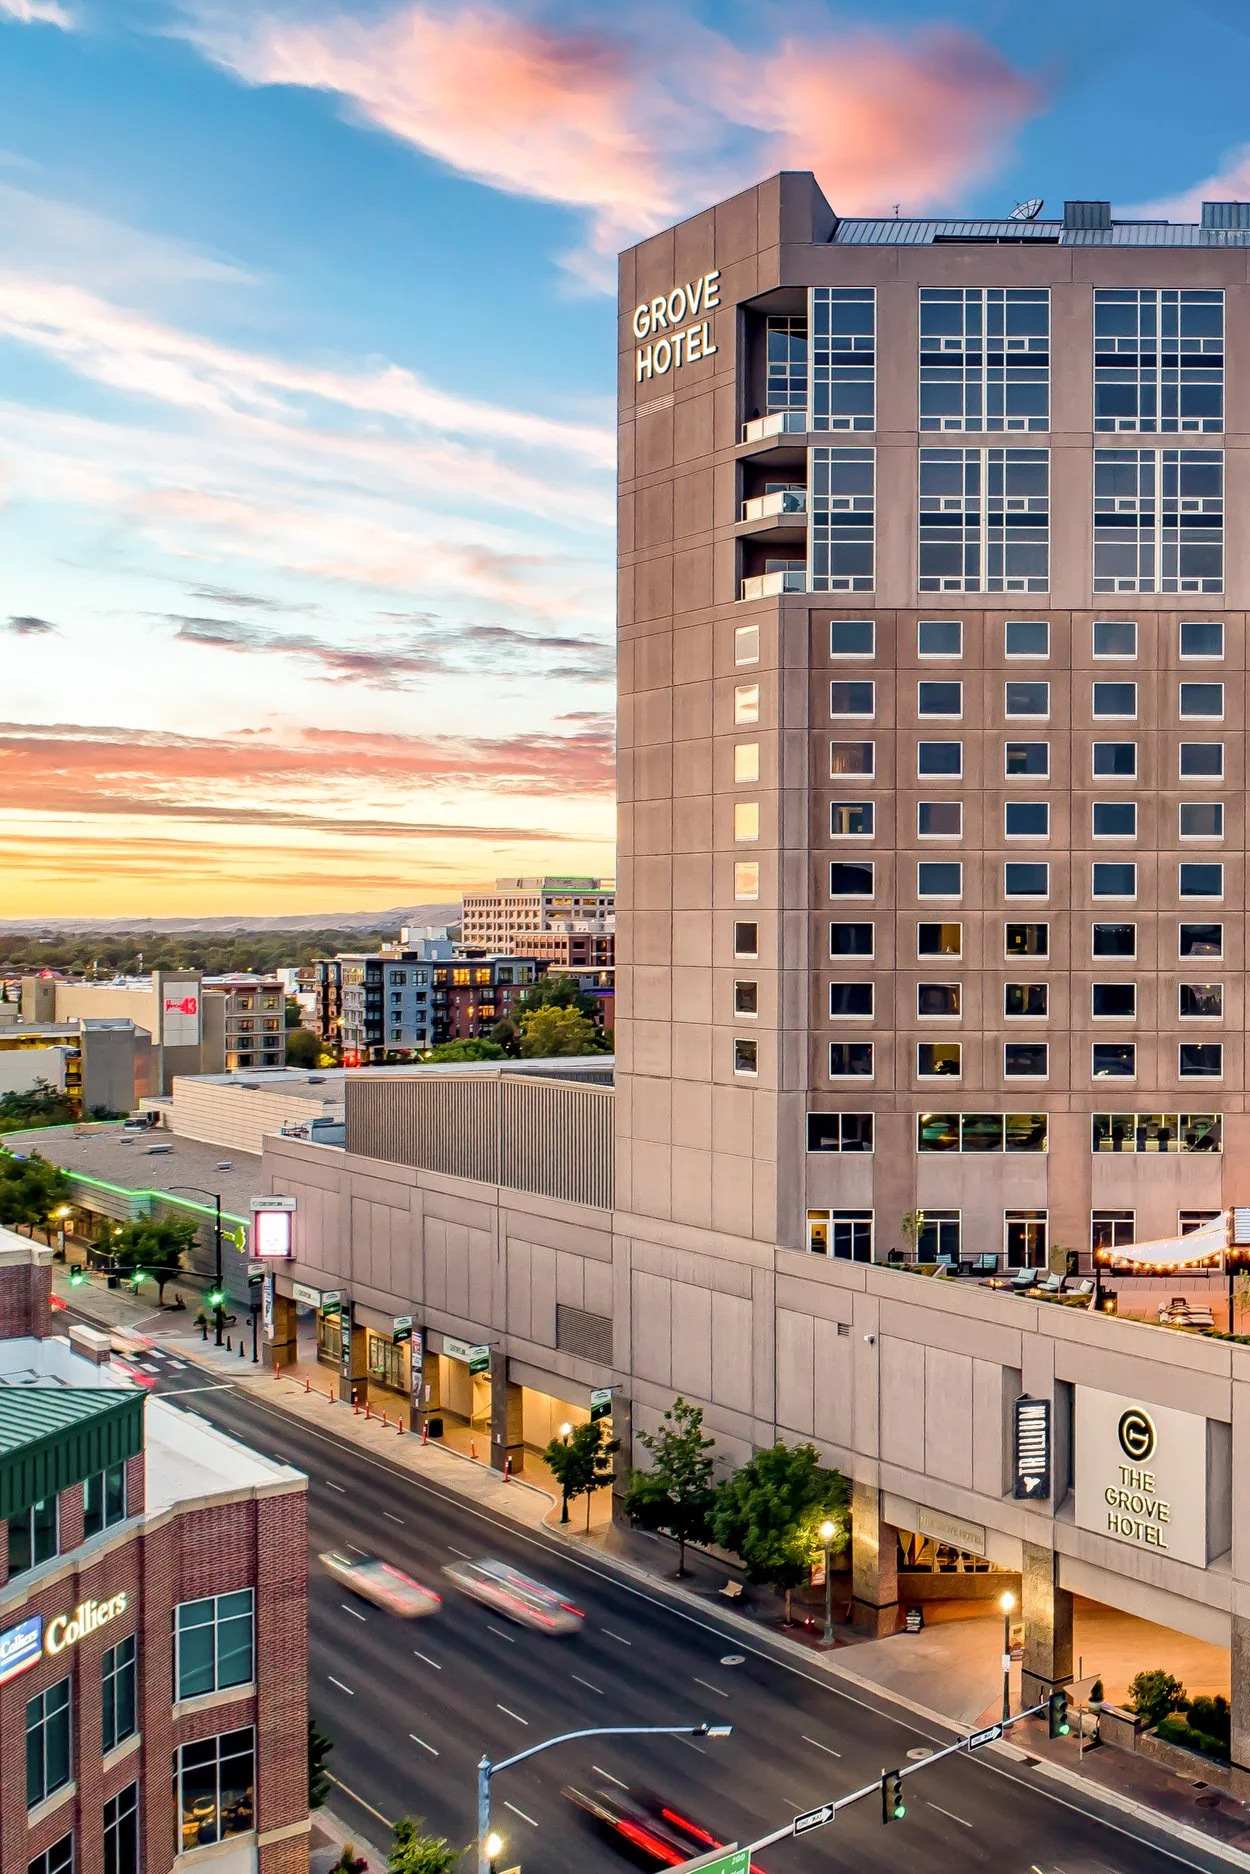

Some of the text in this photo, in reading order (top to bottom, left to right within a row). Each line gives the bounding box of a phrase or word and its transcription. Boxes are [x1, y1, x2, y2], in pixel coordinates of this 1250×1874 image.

[633, 270, 720, 339] GROVE
[637, 321, 717, 382] HOTEL
[1018, 1405, 1046, 1476] TRILLIUM
[1118, 1464, 1157, 1494] THE
[1104, 1487, 1171, 1523] GROVE
[1107, 1511, 1169, 1549] HOTEL
[44, 1590, 128, 1656] Colliers
[0, 1629, 38, 1659] Colliers
[731, 1853, 746, 1866] 200
